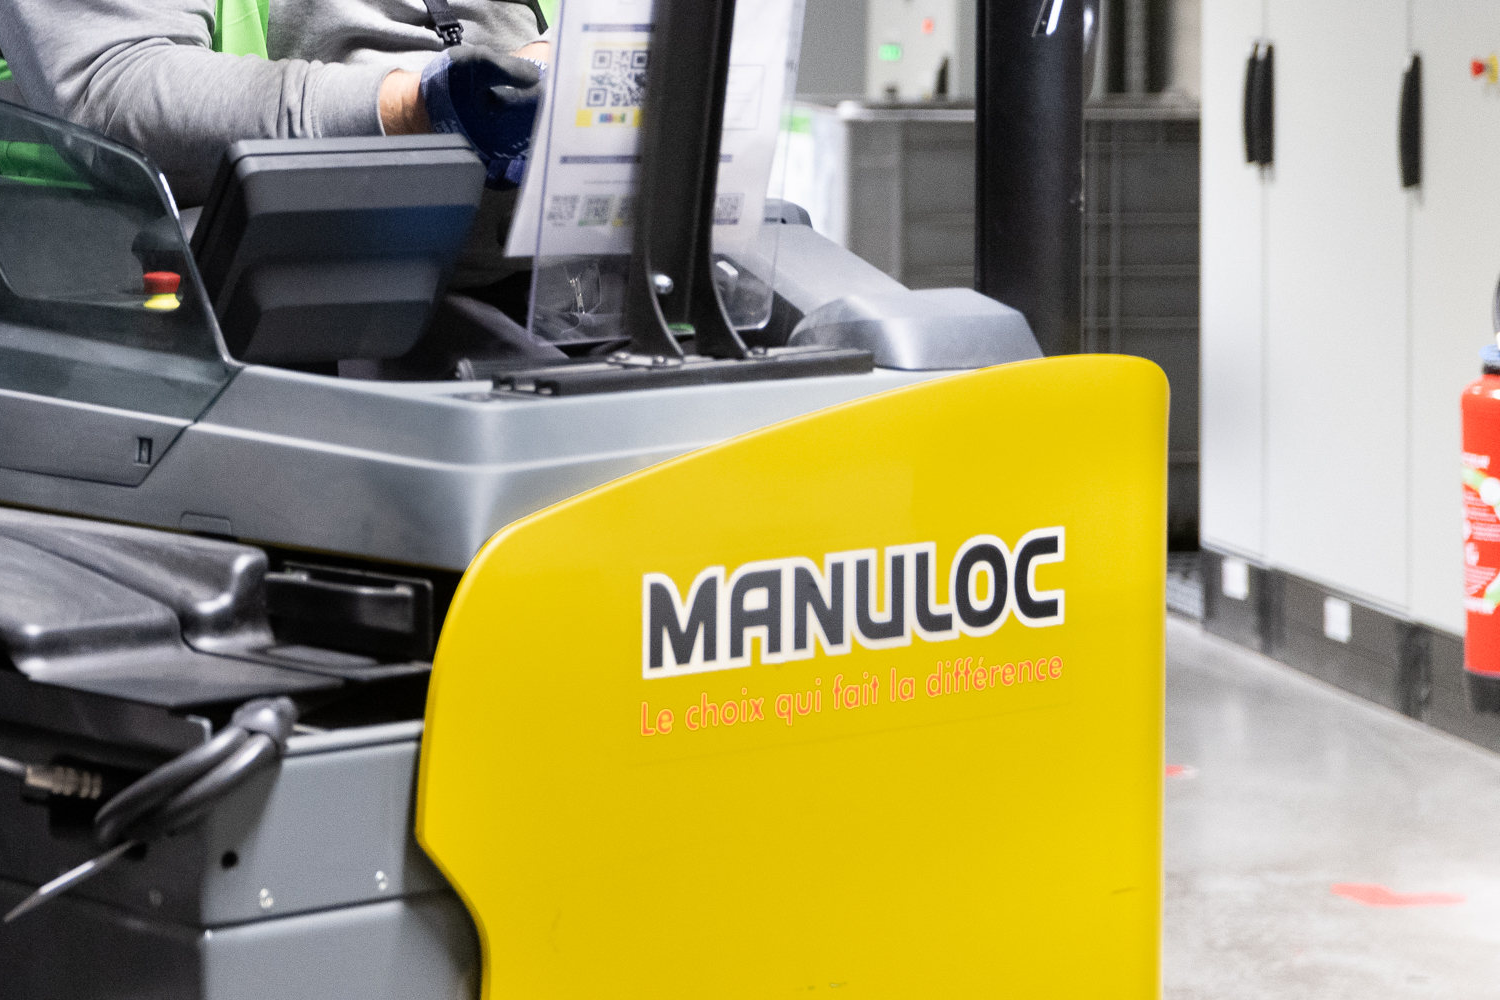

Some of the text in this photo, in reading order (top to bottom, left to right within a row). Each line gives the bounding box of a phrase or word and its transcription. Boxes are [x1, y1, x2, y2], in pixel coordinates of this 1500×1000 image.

[644, 528, 1063, 676] MANULOC
[641, 655, 1064, 737] Le choix qui fait la différence
